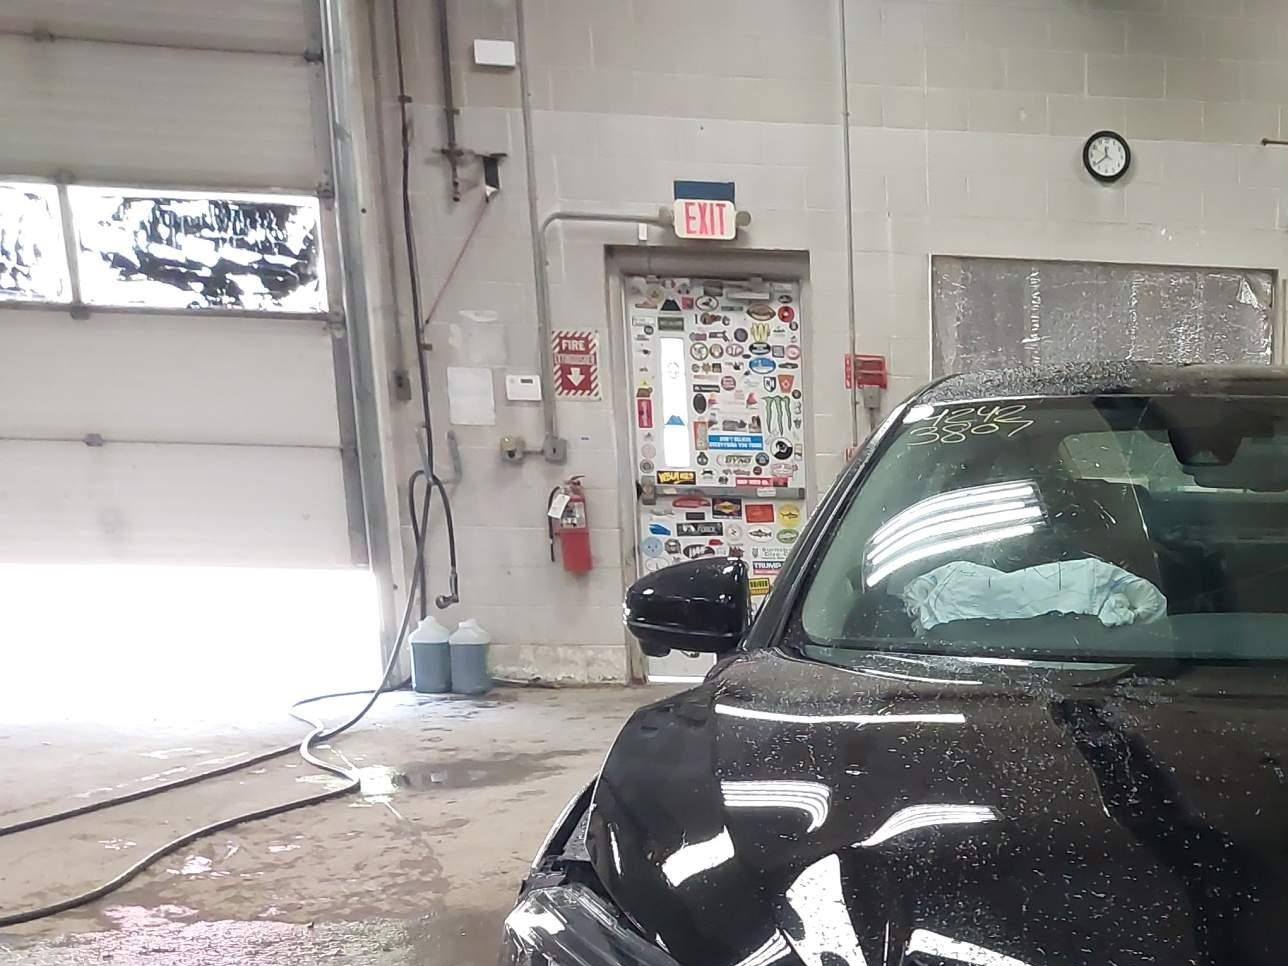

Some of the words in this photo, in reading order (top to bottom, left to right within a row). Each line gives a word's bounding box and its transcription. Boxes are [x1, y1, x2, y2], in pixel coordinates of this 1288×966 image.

[684, 202, 726, 235] EXIT
[562, 339, 585, 351] FIRE
[753, 561, 782, 570] TRUMP
